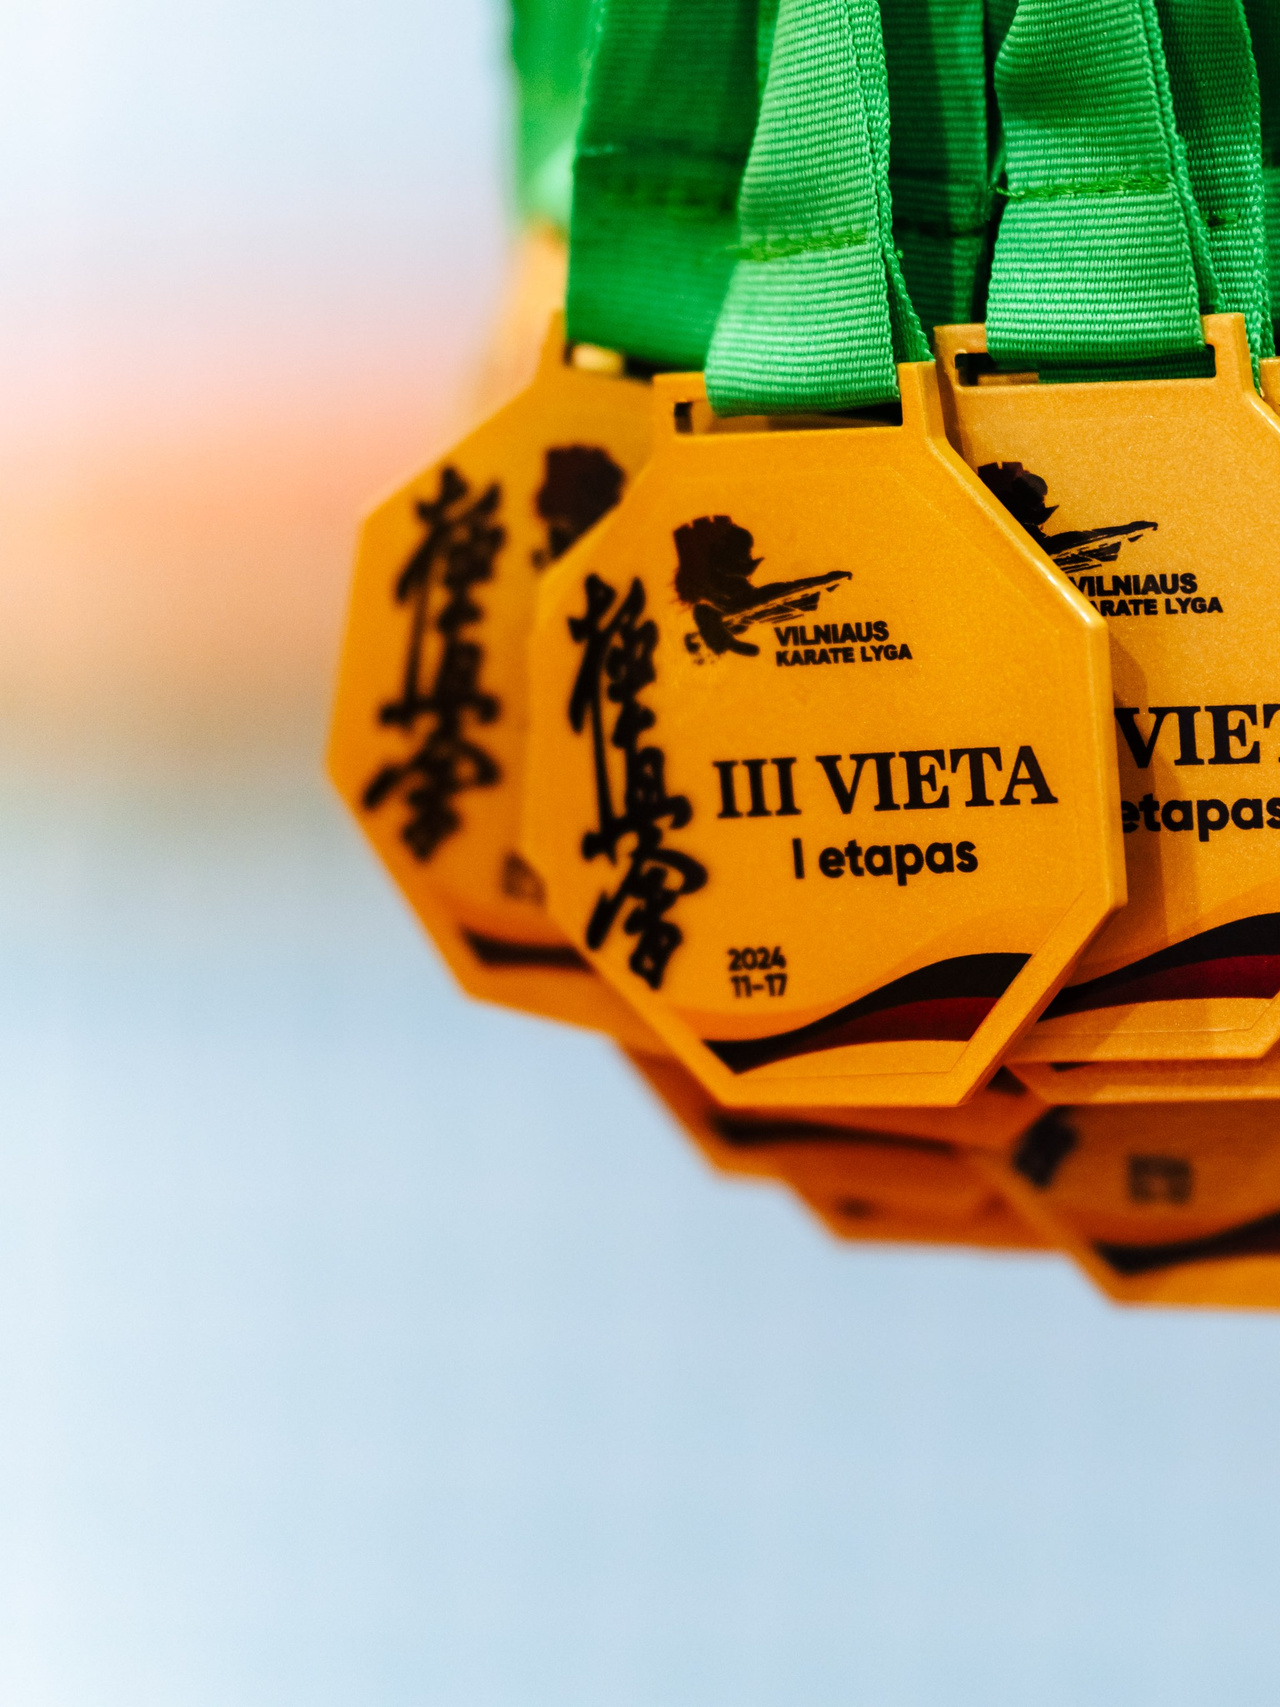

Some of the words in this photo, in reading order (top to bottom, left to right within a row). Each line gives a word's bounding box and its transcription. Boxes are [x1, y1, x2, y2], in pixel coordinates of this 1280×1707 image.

[1164, 596, 1224, 615] LYGA
[773, 620, 890, 647] VILNIAUS
[775, 646, 856, 667] KARATE
[860, 643, 913, 663] LYGA
[712, 757, 802, 819] III
[815, 745, 1059, 815] VIETA
[792, 837, 805, 880] I
[818, 840, 979, 887] etapas
[728, 946, 787, 971] 2024
[731, 973, 788, 998] 11-17
